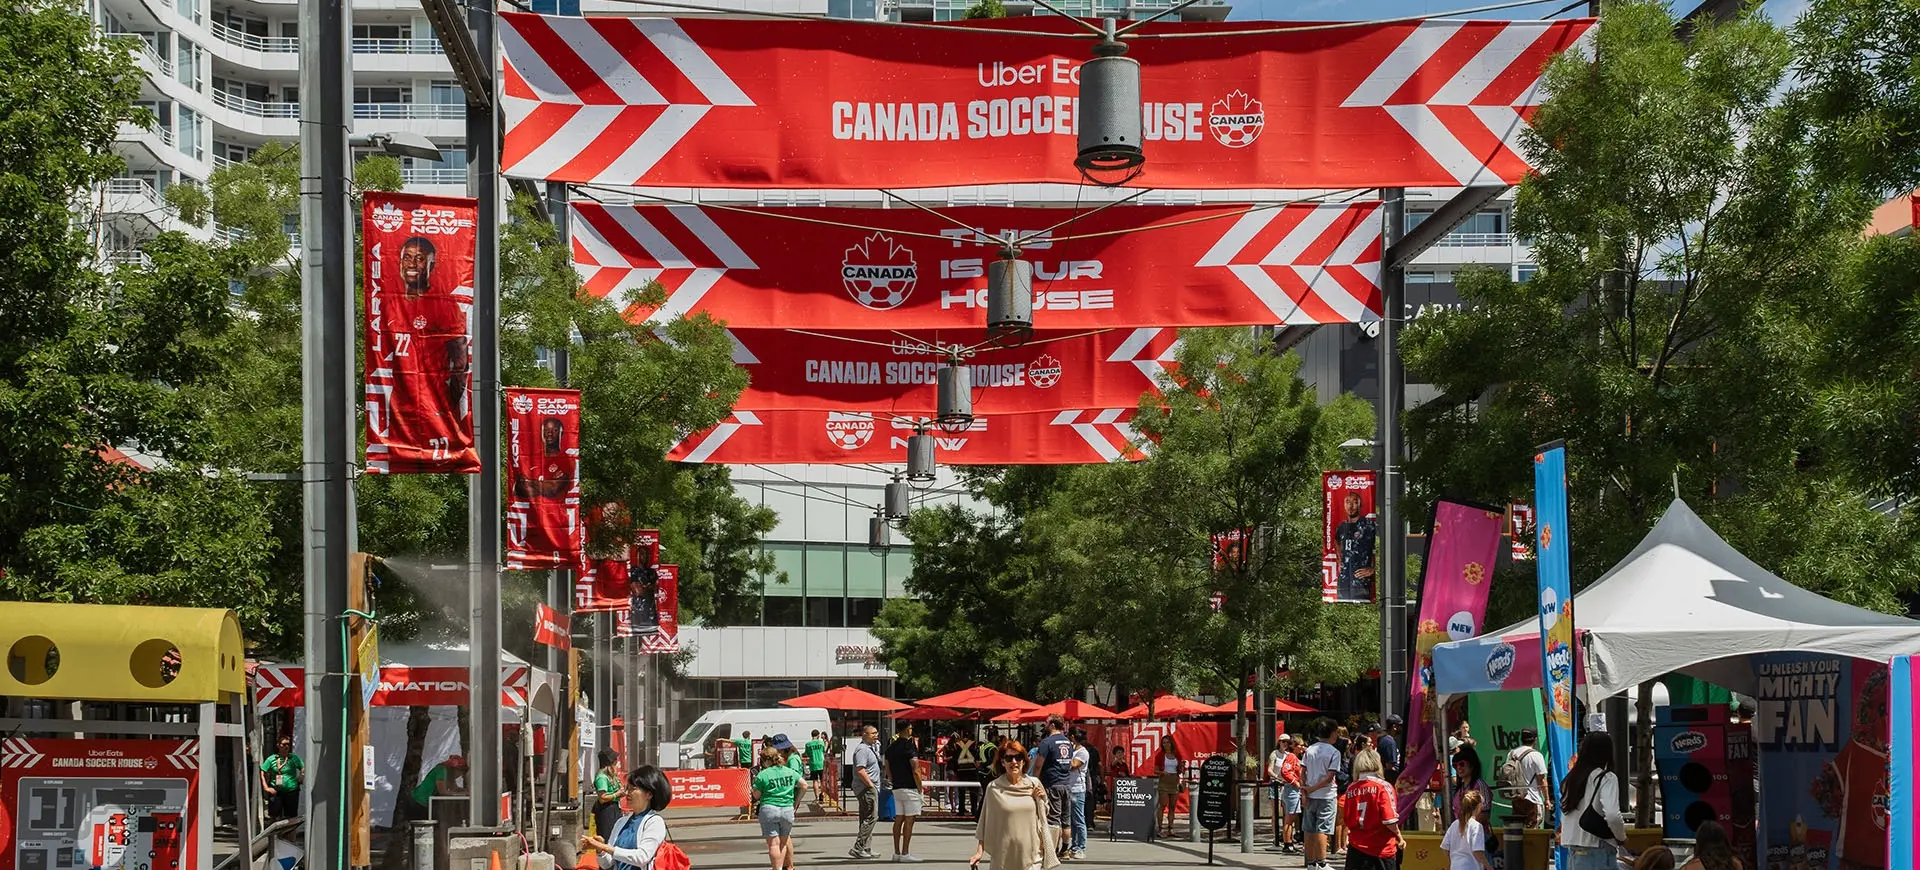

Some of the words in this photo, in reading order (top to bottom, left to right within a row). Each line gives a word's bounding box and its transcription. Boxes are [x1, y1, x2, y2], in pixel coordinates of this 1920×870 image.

[978, 62, 1046, 88] Uber
[1053, 59, 1080, 85] Ea
[832, 101, 959, 141] CANADA
[968, 96, 1079, 140] SOCCE
[1142, 103, 1203, 141] USE
[1210, 114, 1264, 126] CANADA
[372, 213, 404, 223] CANADA
[411, 208, 456, 218] OUR
[411, 217, 473, 228] GAME
[411, 226, 460, 235] NOW
[940, 228, 1053, 249] THIS
[843, 266, 917, 280] CANADA
[940, 258, 983, 279] IS
[1031, 259, 1103, 280] UR
[371, 241, 382, 352] LARYEA
[394, 332, 411, 358] 22
[891, 340, 930, 355] Uber
[805, 359, 881, 385] CANADA
[885, 361, 949, 385] SOCC
[1029, 367, 1062, 378] CANADA
[826, 420, 875, 431] CANADA
[429, 437, 452, 462] 22
[510, 418, 520, 468] KONÉ
[890, 436, 968, 451] NW
[1450, 622, 1473, 634] NEW
[1760, 661, 1809, 676] UNLEASH
[1810, 660, 1840, 673] YOUR
[1759, 673, 1840, 698] MIGHTY
[1758, 698, 1836, 744] FAN
[1491, 724, 1521, 751] Uber
[88, 749, 106, 757] Uber
[107, 749, 124, 757] Eats
[52, 758, 84, 768] CANADA
[85, 758, 117, 768] SOCCER
[118, 758, 143, 768] HOUSE
[768, 775, 794, 790] STAFF
[1713, 773, 1728, 781] 100
[671, 792, 725, 800] HOUSE
[1347, 786, 1377, 799] BECKHAM
[1357, 801, 1368, 829] 7
[1719, 813, 1731, 821] 50
